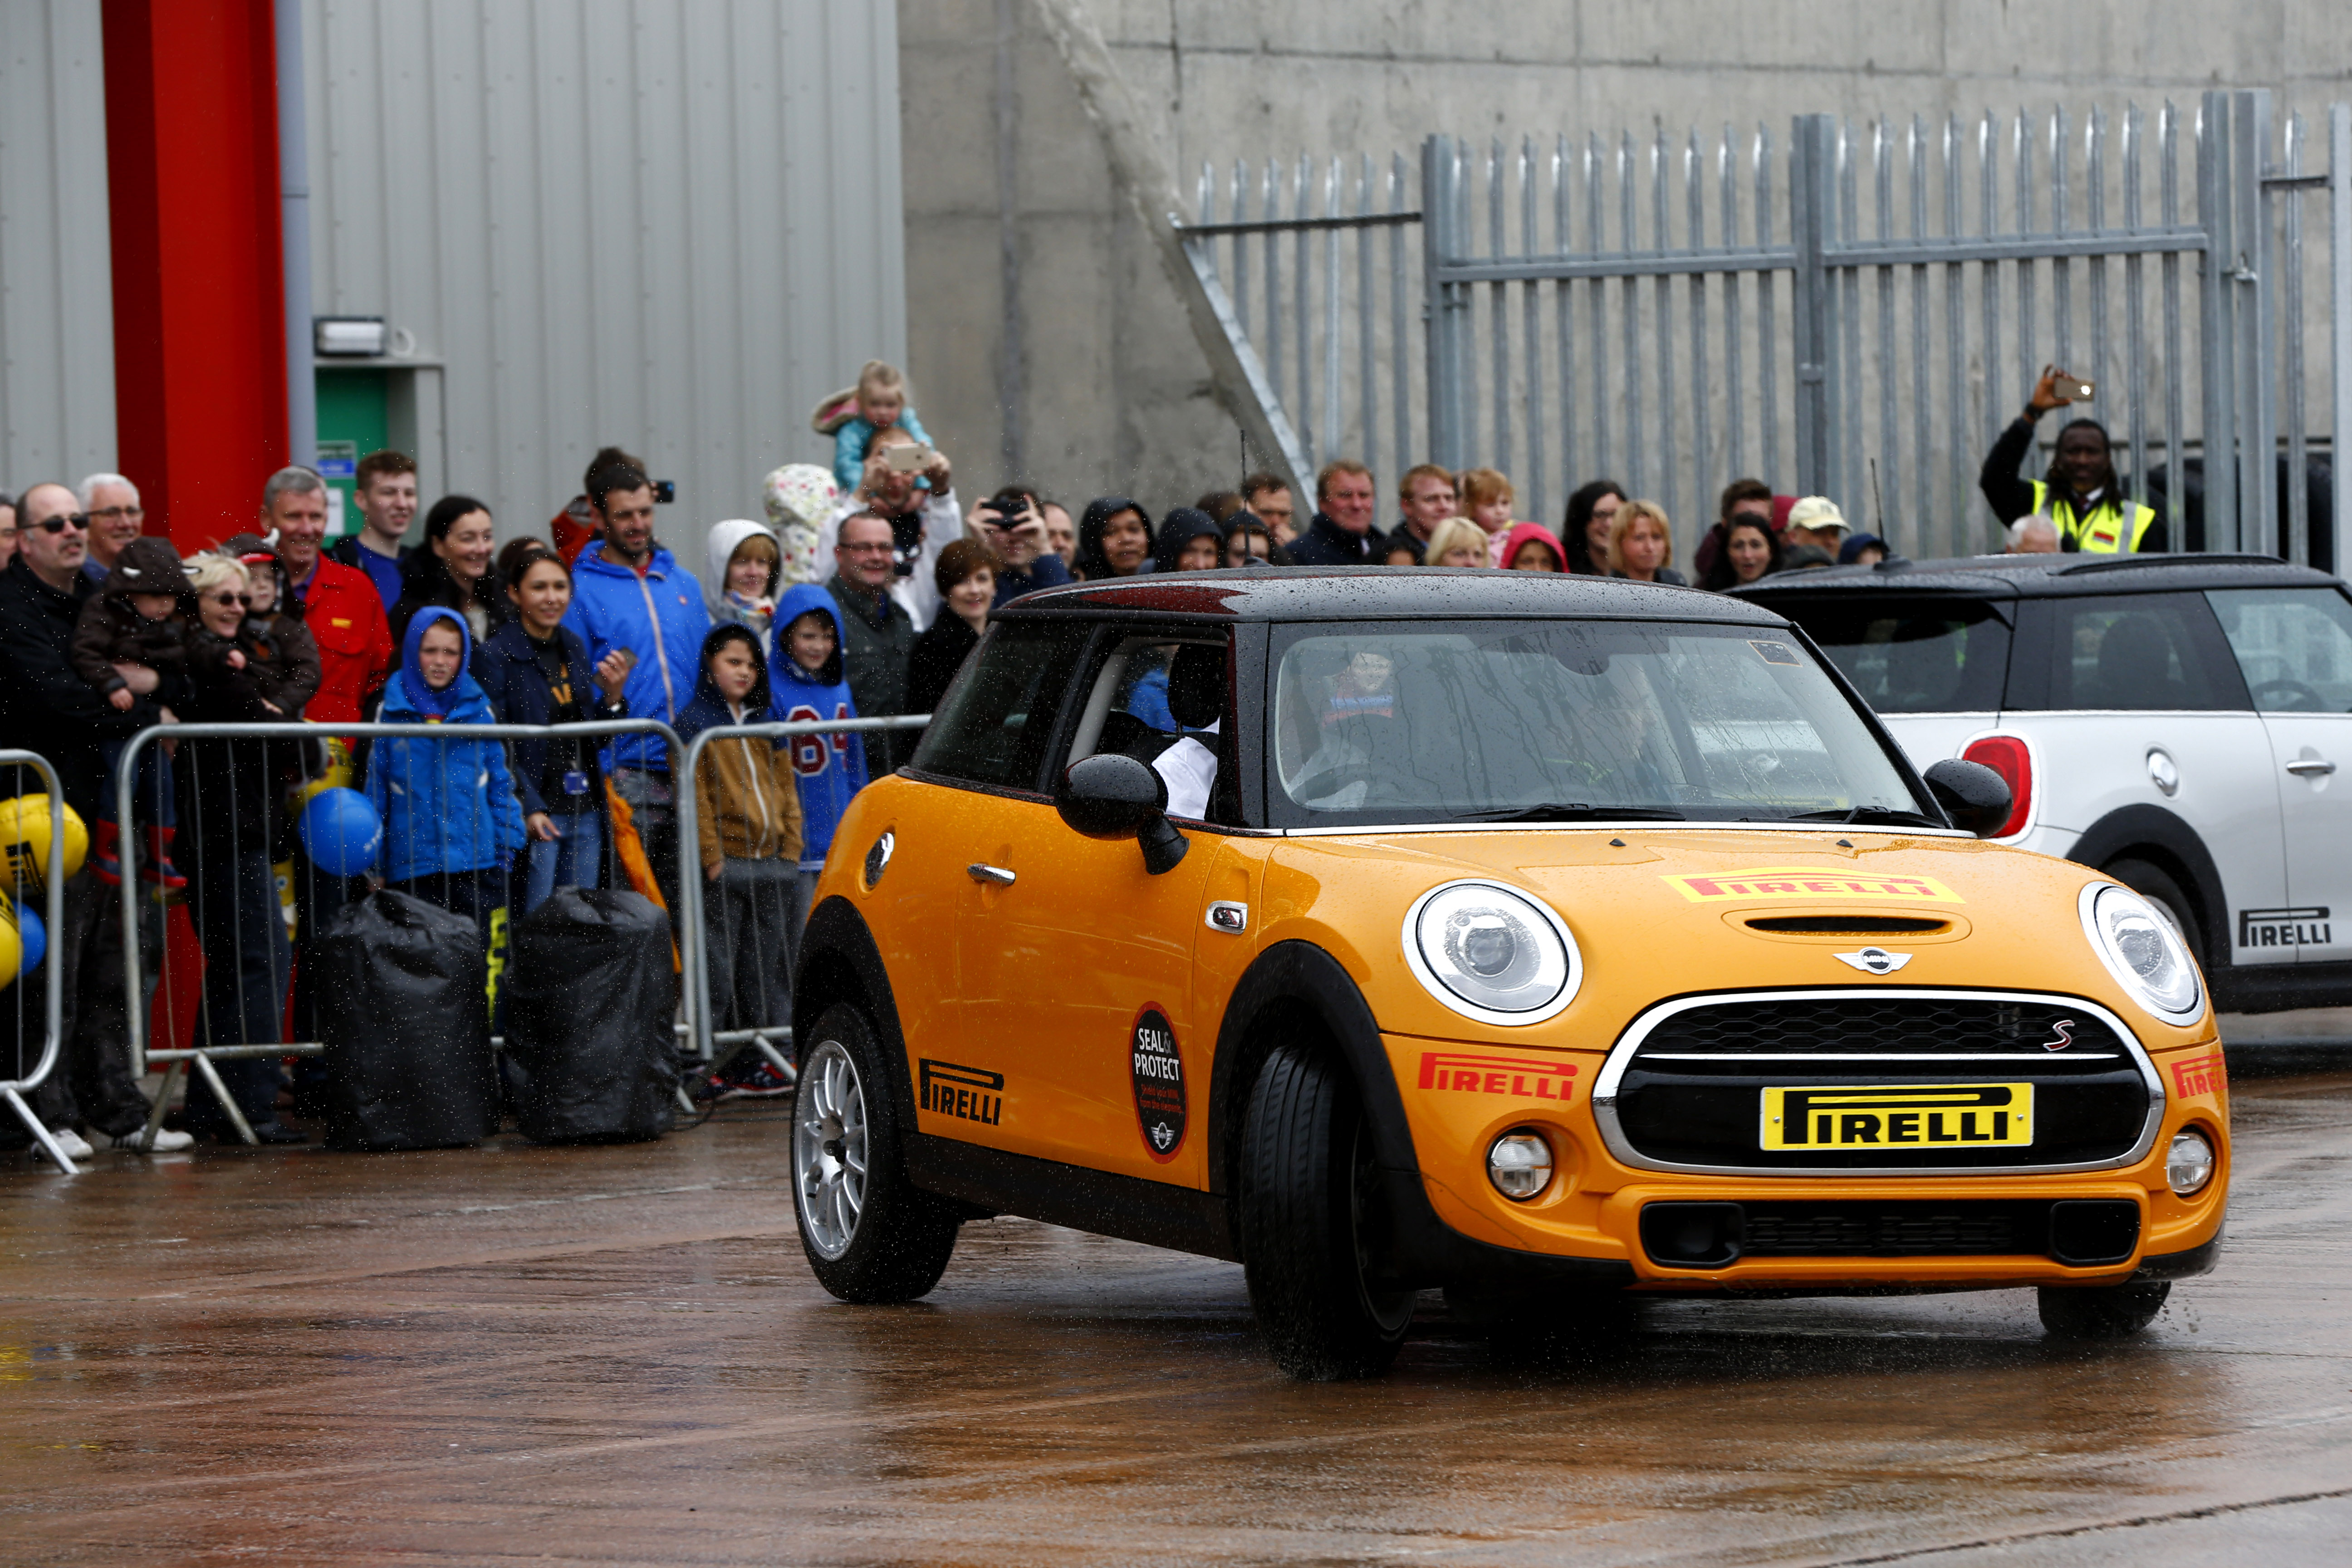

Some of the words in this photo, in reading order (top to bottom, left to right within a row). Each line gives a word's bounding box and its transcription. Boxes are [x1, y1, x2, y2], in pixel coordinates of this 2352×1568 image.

[1681, 872, 1937, 897] PIRELLI
[2239, 906, 2331, 947] PIRELLI
[2043, 1019, 2075, 1052] S
[1134, 1053, 1180, 1081] PROTECT
[1418, 1052, 1578, 1101] PIRELLI
[919, 1058, 1004, 1126] PIRELLI
[1783, 1086, 2012, 1145] PIRELLI
